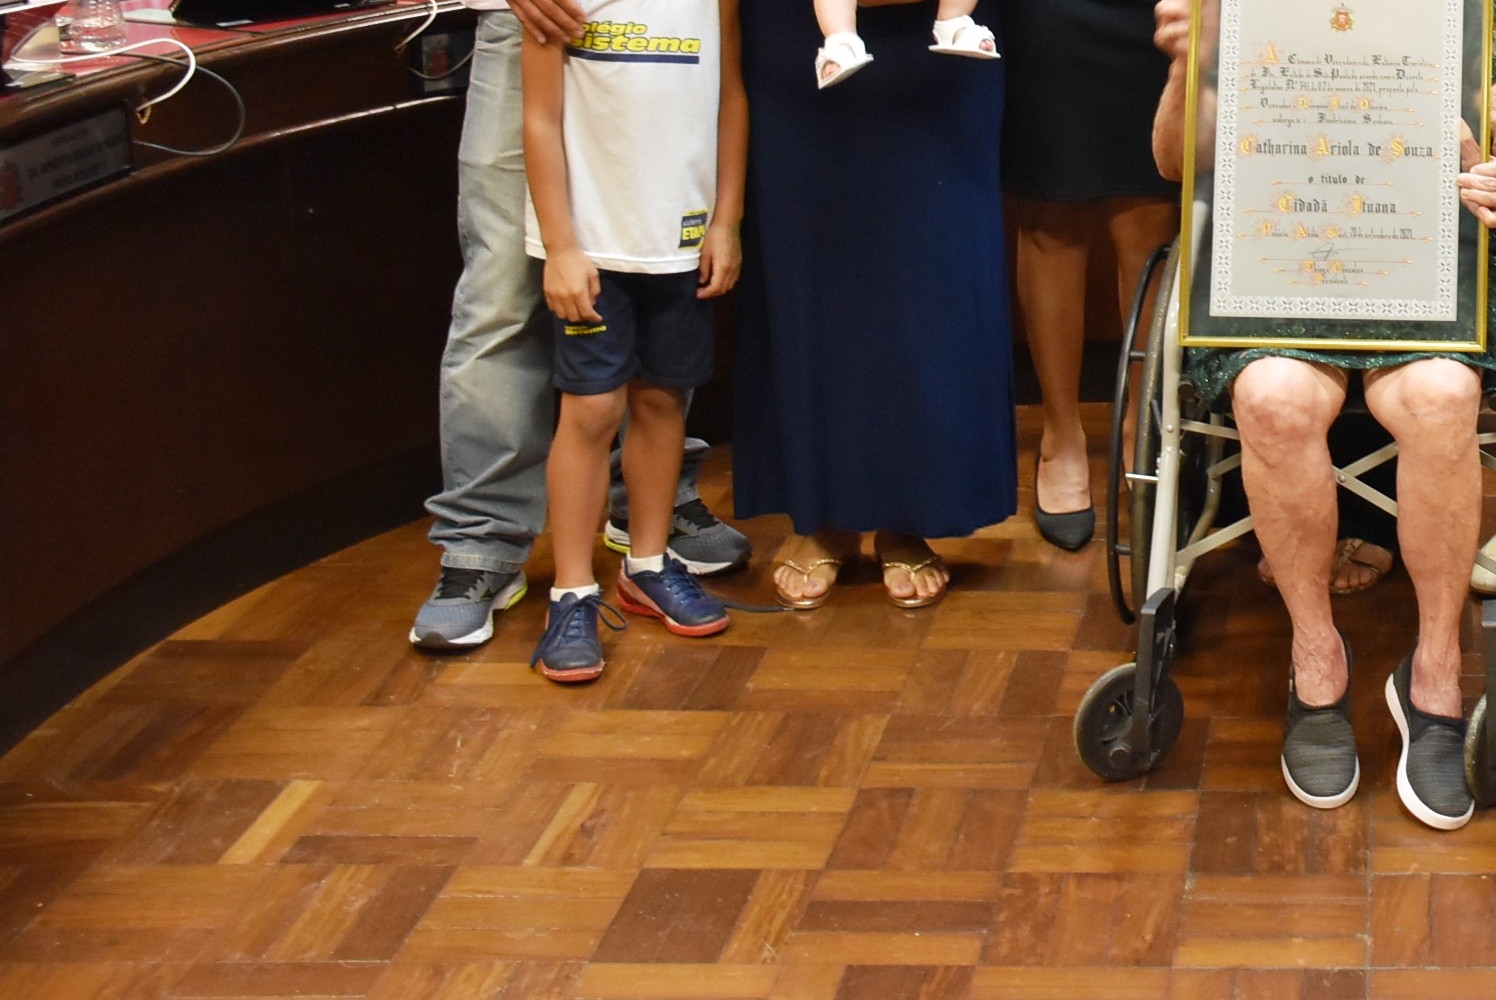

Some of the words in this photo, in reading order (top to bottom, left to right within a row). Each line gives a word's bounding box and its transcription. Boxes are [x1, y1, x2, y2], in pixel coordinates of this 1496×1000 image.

[580, 21, 648, 36] olégio
[1240, 136, 1307, 157] Catharina
[1316, 135, 1360, 157] Ariola
[1368, 142, 1382, 157] de
[1391, 136, 1433, 158] Souza
[1279, 194, 1328, 213] Cidadã
